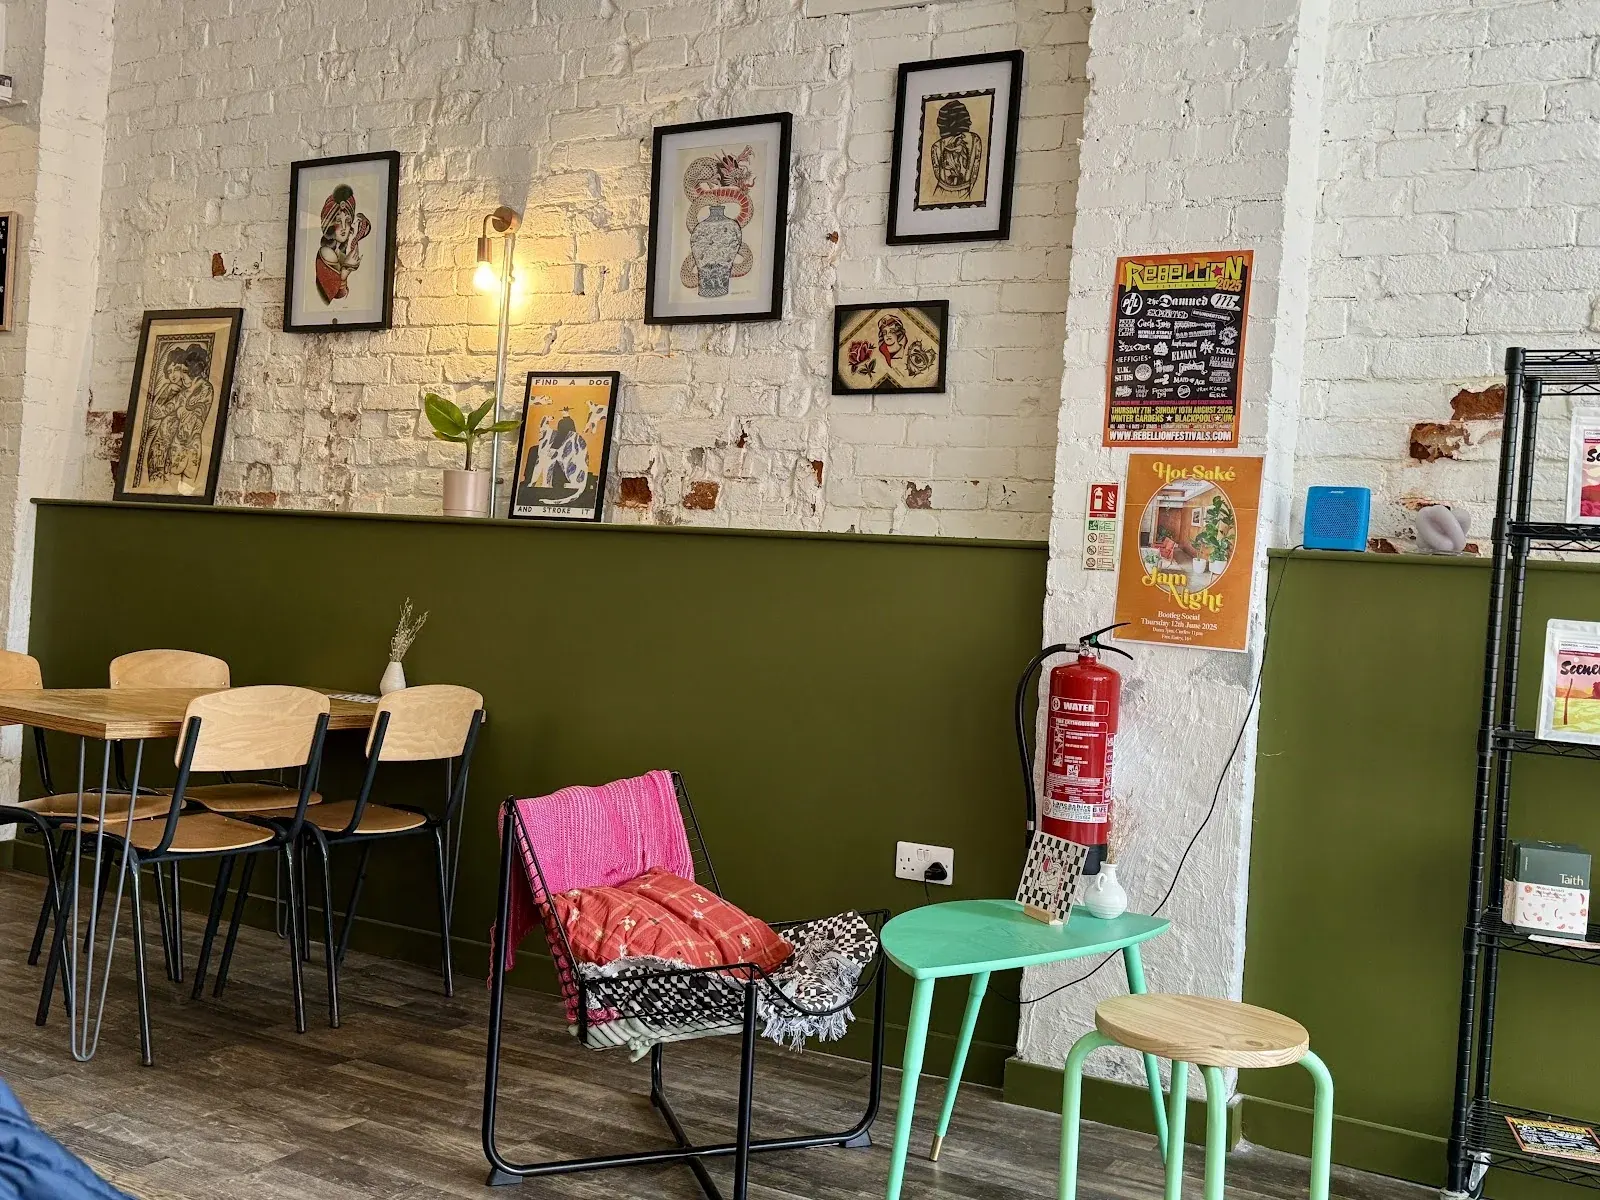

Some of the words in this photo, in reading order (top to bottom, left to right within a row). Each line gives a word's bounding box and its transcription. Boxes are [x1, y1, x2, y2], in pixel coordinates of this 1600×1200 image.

[1216, 279, 1242, 292] 2025
[1159, 295, 1208, 307] Damned
[1111, 406, 1141, 414] THURSDAY
[1141, 406, 1151, 414] 7TH
[1155, 406, 1177, 414] SUNDAY
[1178, 406, 1192, 414] 10TH
[1193, 406, 1216, 414] AUGUST
[1217, 406, 1233, 414] 2025
[1111, 414, 1134, 422] WINTER
[1135, 414, 1164, 422] GARDENS
[1175, 414, 1211, 422] BLACKPOOL
[1109, 431, 1232, 441] WWW.REBELLIONFESTIVALS.COM
[1153, 461, 1188, 484] Hot
[1191, 465, 1236, 482] Saké
[1142, 566, 1187, 586] Jam
[1168, 583, 1224, 613] Night
[1158, 611, 1180, 620] Bootleg
[1141, 618, 1169, 627] Thursday
[1063, 702, 1095, 713] WATER
[1559, 873, 1584, 886] Taith
